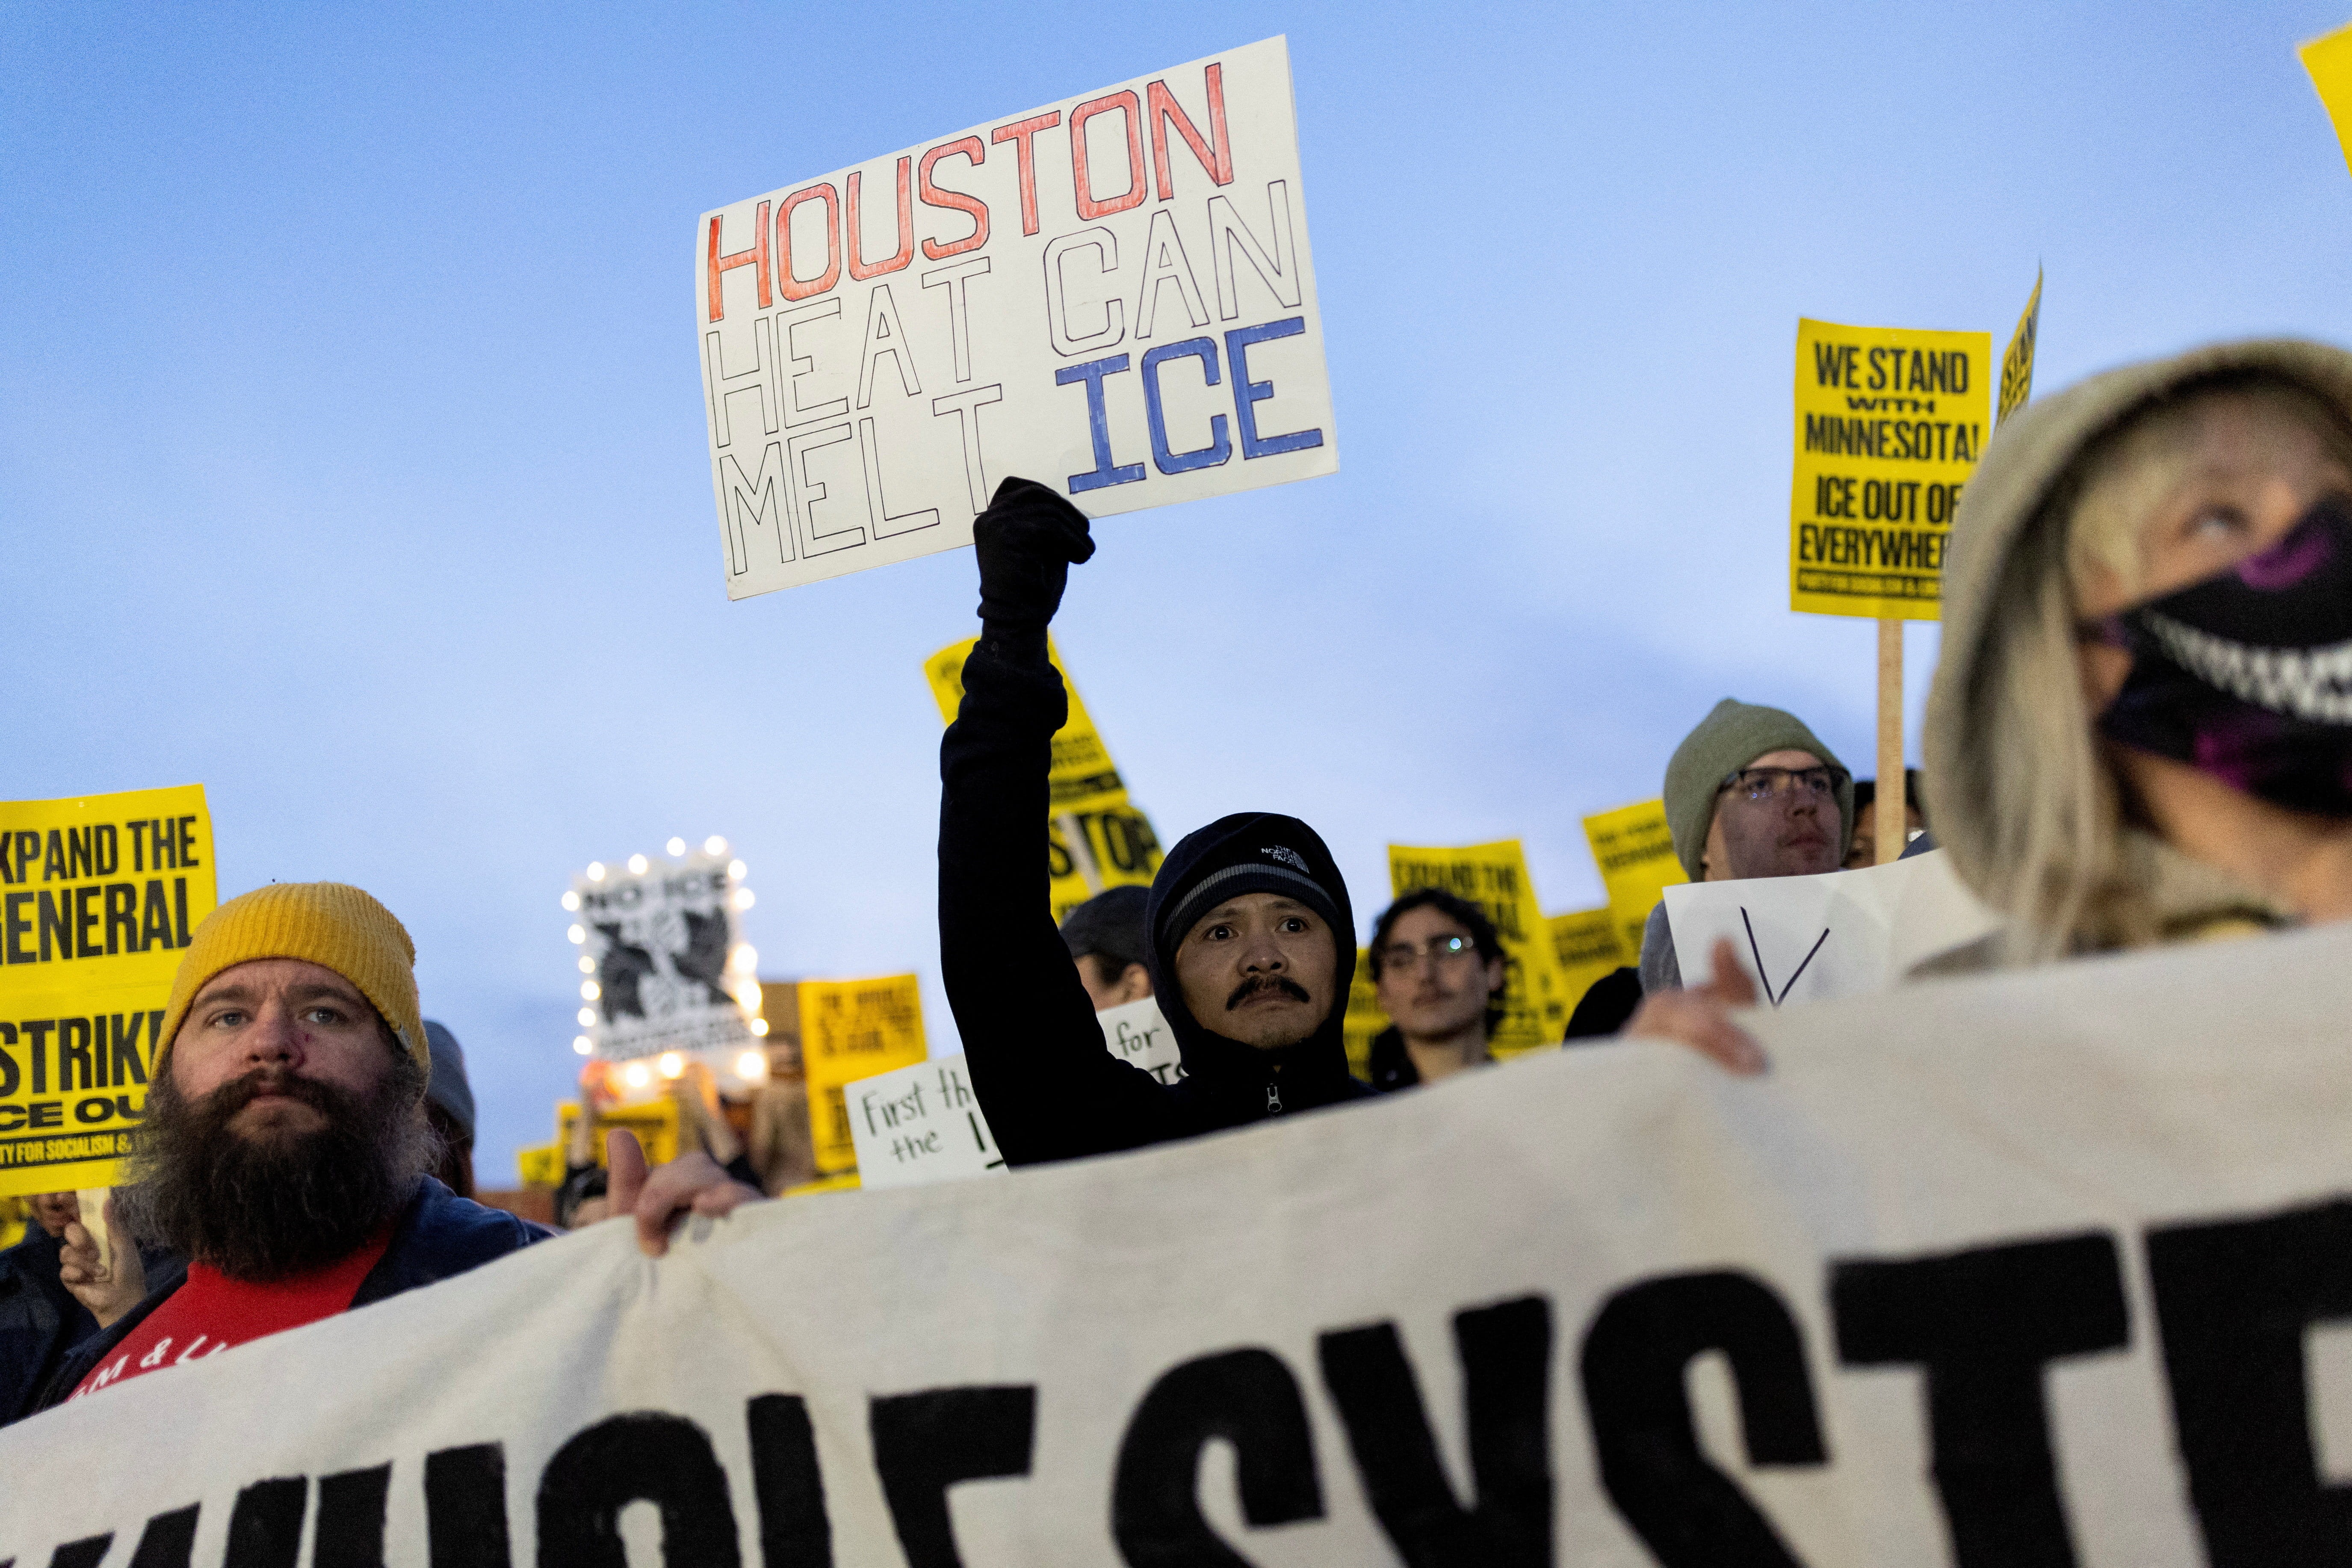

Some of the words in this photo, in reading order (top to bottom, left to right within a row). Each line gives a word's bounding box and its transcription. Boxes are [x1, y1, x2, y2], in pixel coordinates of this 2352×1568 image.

[709, 62, 1234, 323] HOUSTON
[706, 256, 990, 448] HEAT
[1043, 179, 1302, 357] CAN
[1814, 340, 1860, 390] WE
[1867, 345, 1969, 394] STAND
[1846, 396, 1935, 416] WITH
[719, 383, 1002, 576] MELT
[1055, 316, 1324, 495] ICE
[1817, 475, 1858, 518] ICE
[1864, 479, 1921, 523] OUT
[1800, 523, 1950, 570] EVERYWHE
[0, 824, 118, 884] XPAND
[127, 815, 199, 872] THE
[1261, 848, 1295, 861] NORTH
[1273, 854, 1295, 866] FACE
[1274, 845, 1291, 853] THE
[0, 877, 193, 966] ENERAL
[1117, 1021, 1161, 1057] for
[0, 1101, 63, 1132] CE
[74, 1094, 148, 1124] OU
[861, 1081, 927, 1136] First
[938, 1067, 972, 1109] th
[16, 1142, 45, 1163] FOR
[46, 1134, 114, 1160] SOCIALISM
[889, 1129, 943, 1163] the
[140, 1337, 174, 1368] &
[1111, 1194, 2352, 1568] SYSTE
